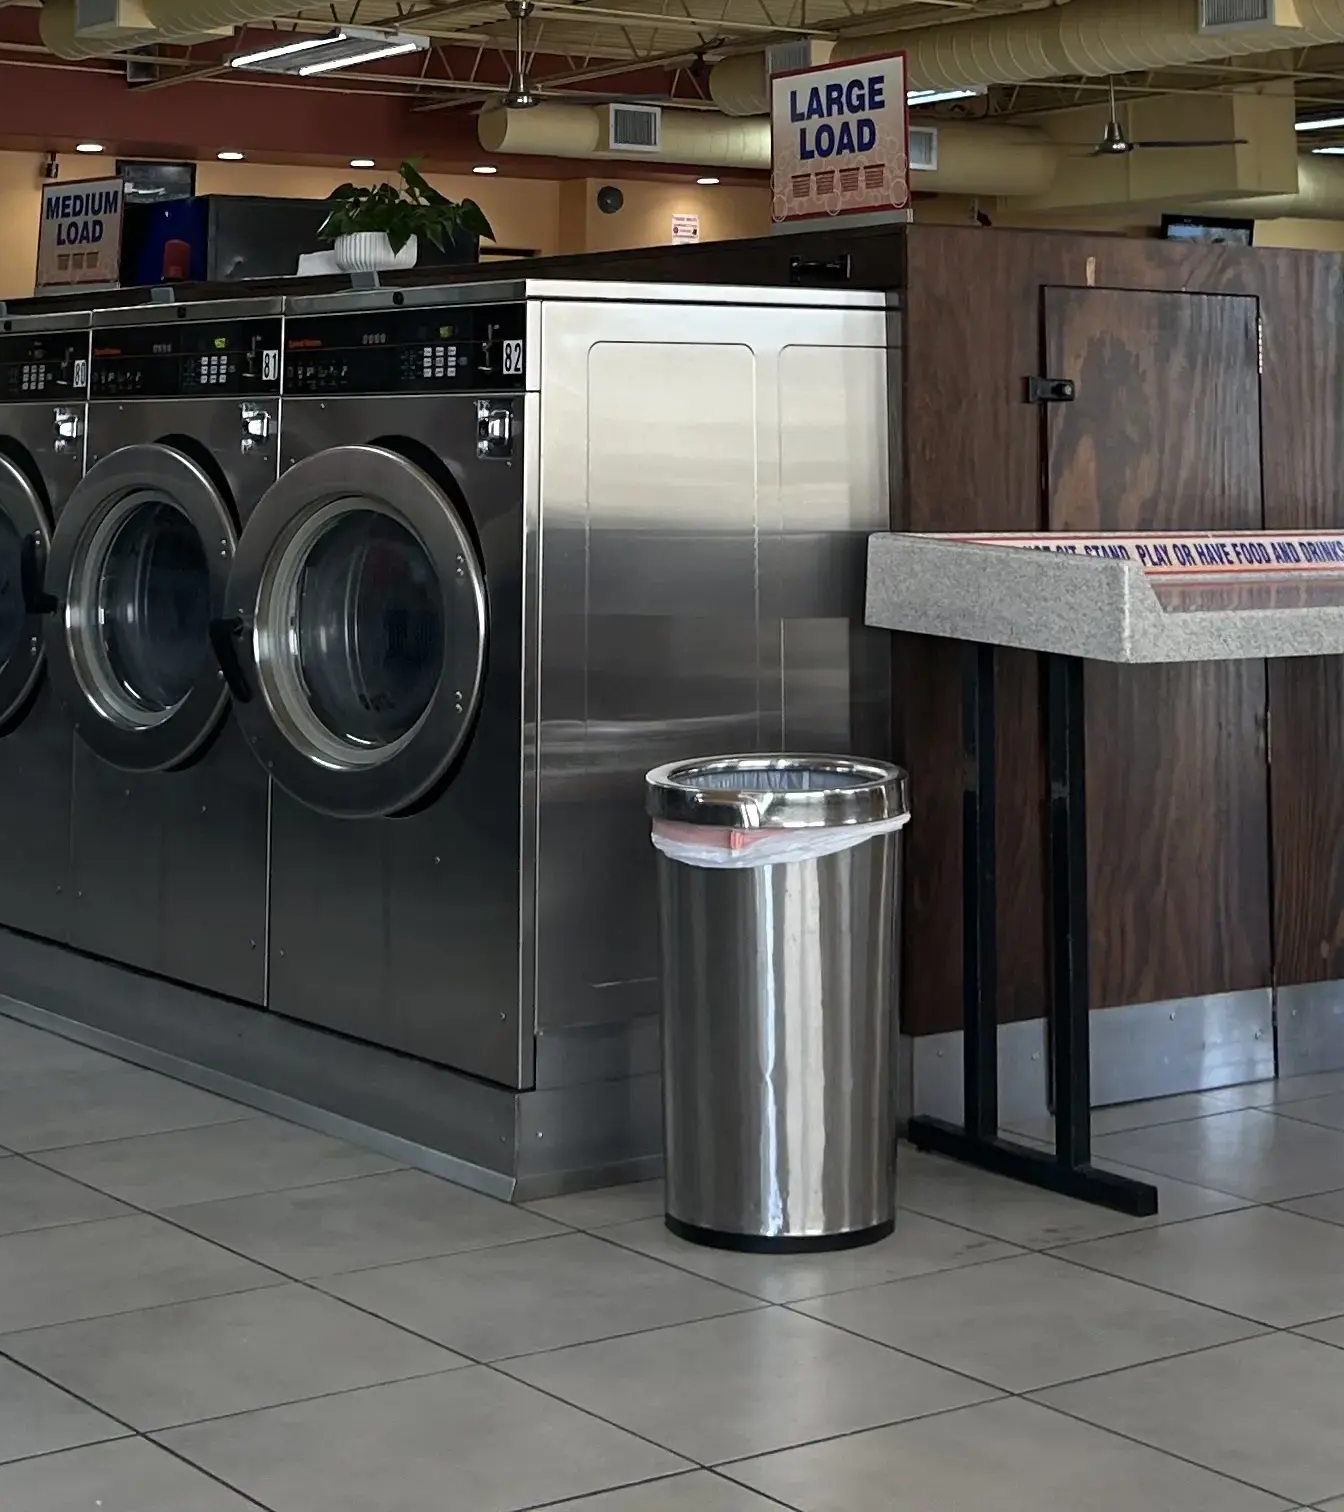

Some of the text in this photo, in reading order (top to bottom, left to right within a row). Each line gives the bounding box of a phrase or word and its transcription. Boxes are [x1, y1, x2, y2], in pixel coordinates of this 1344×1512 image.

[790, 75, 885, 123] LARGE
[799, 118, 877, 160] LOAD
[46, 190, 119, 220] MEDIUM
[56, 219, 104, 246] LOAD
[263, 352, 278, 379] 81
[504, 342, 522, 373] 82
[75, 361, 86, 386] 80
[1135, 544, 1173, 566] PLAY
[1174, 543, 1196, 566] OR
[1196, 543, 1234, 565] HAVE
[1233, 543, 1271, 565] FOOD
[1269, 542, 1301, 564] AND
